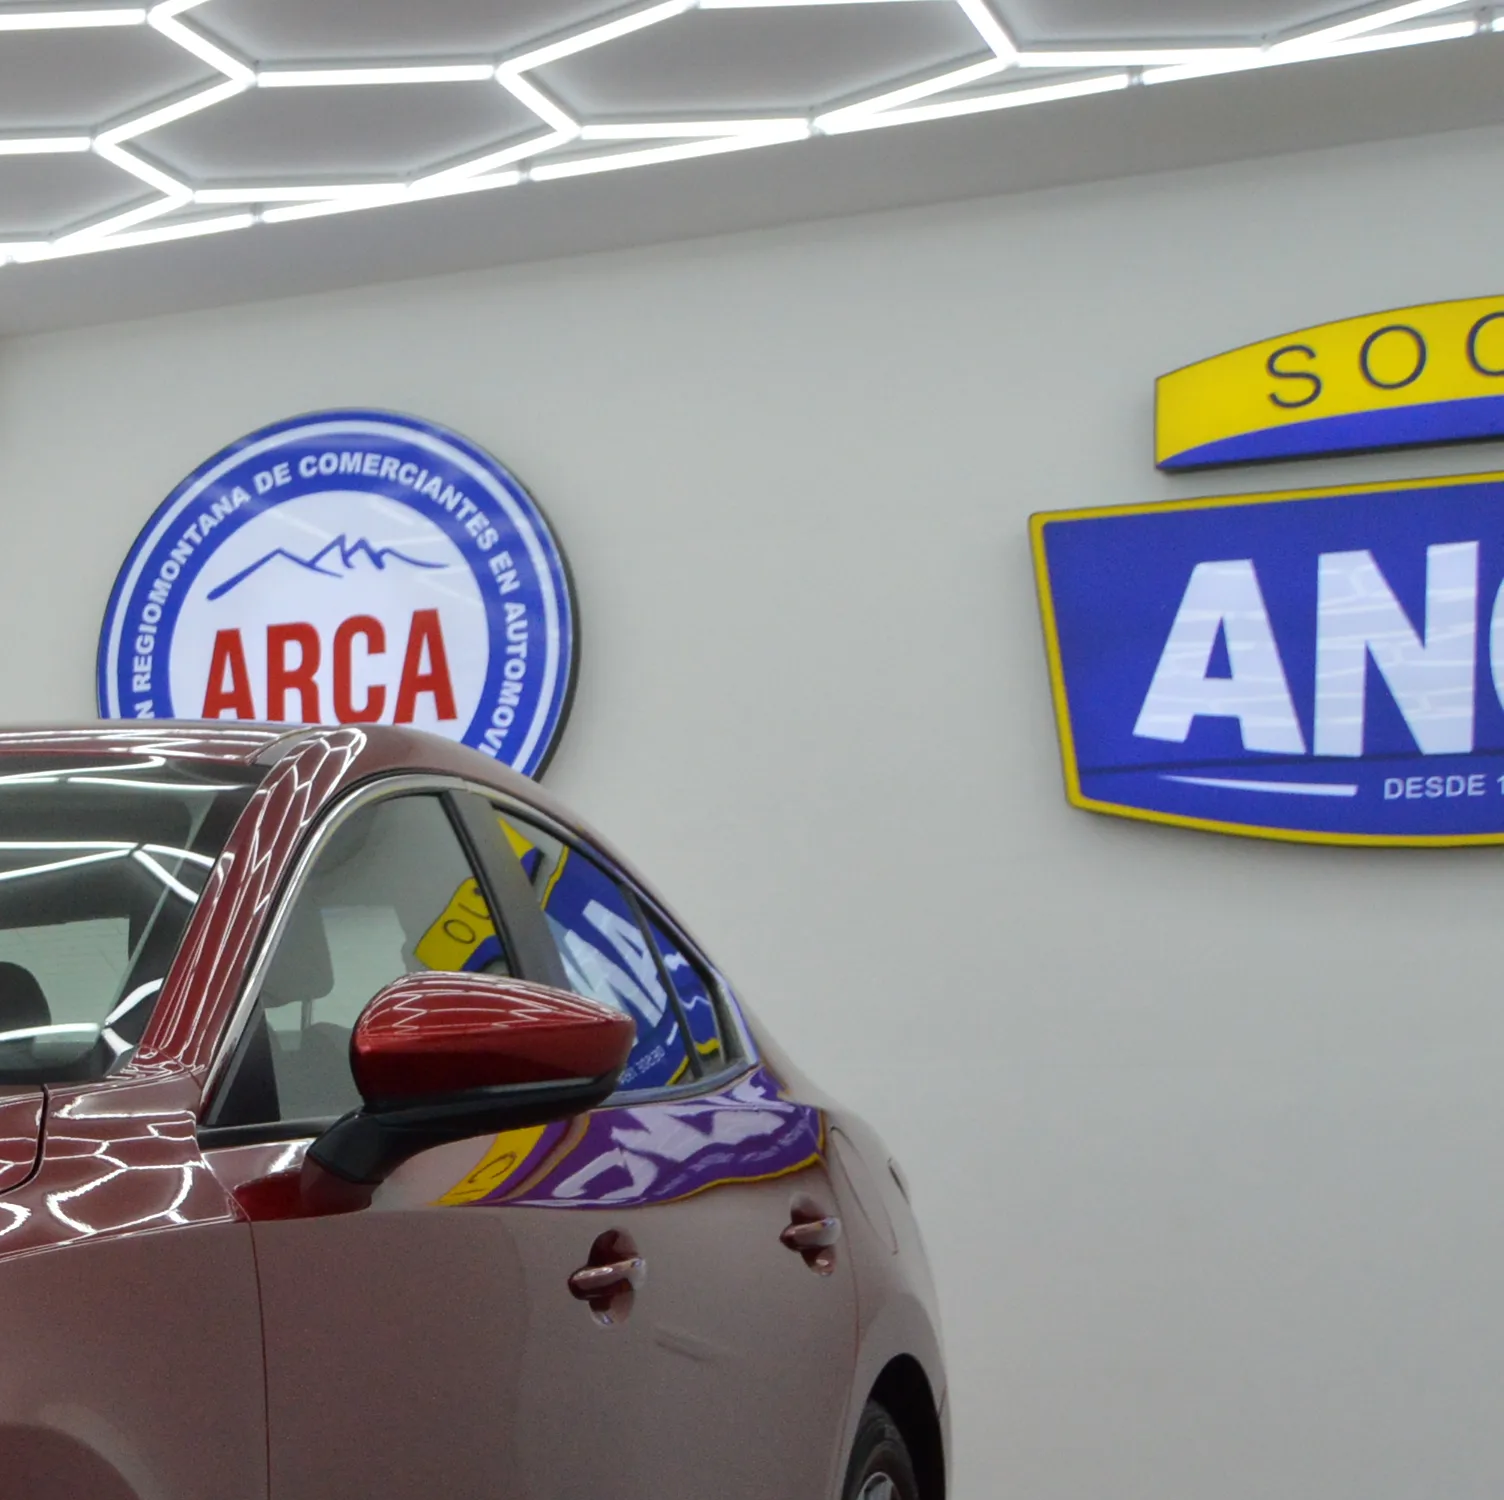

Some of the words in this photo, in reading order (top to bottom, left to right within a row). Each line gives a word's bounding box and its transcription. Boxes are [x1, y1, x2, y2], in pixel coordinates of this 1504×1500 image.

[132, 486, 250, 693] REGIOMONTANA
[253, 462, 292, 495] DE
[298, 451, 498, 551] COMERCIANTES
[489, 549, 521, 596] EN
[201, 607, 458, 725] ARCA
[1384, 773, 1487, 800] DESDE
